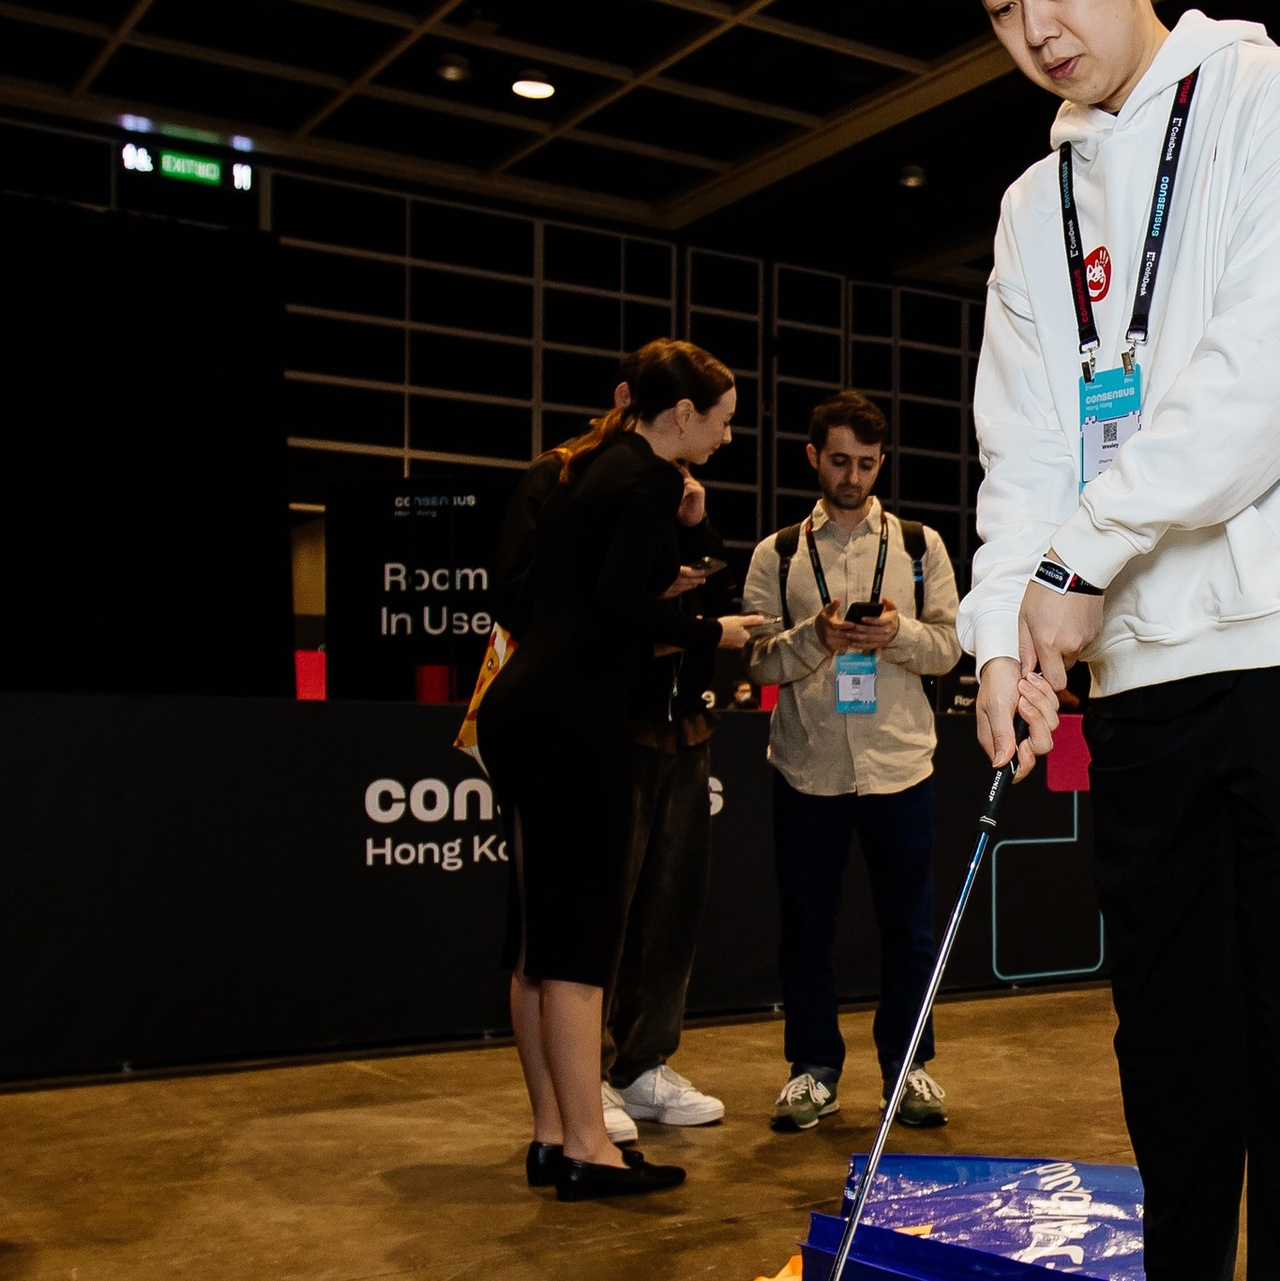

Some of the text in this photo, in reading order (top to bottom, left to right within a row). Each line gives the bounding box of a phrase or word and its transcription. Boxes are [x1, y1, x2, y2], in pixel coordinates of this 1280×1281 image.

[1165, 126, 1180, 161] CoinDesk
[1139, 261, 1154, 297] CoinDesk
[384, 562, 489, 592] Room
[381, 606, 492, 635] In Use
[988, 770, 1003, 802] DUNLOP
[366, 837, 463, 871] Hong
